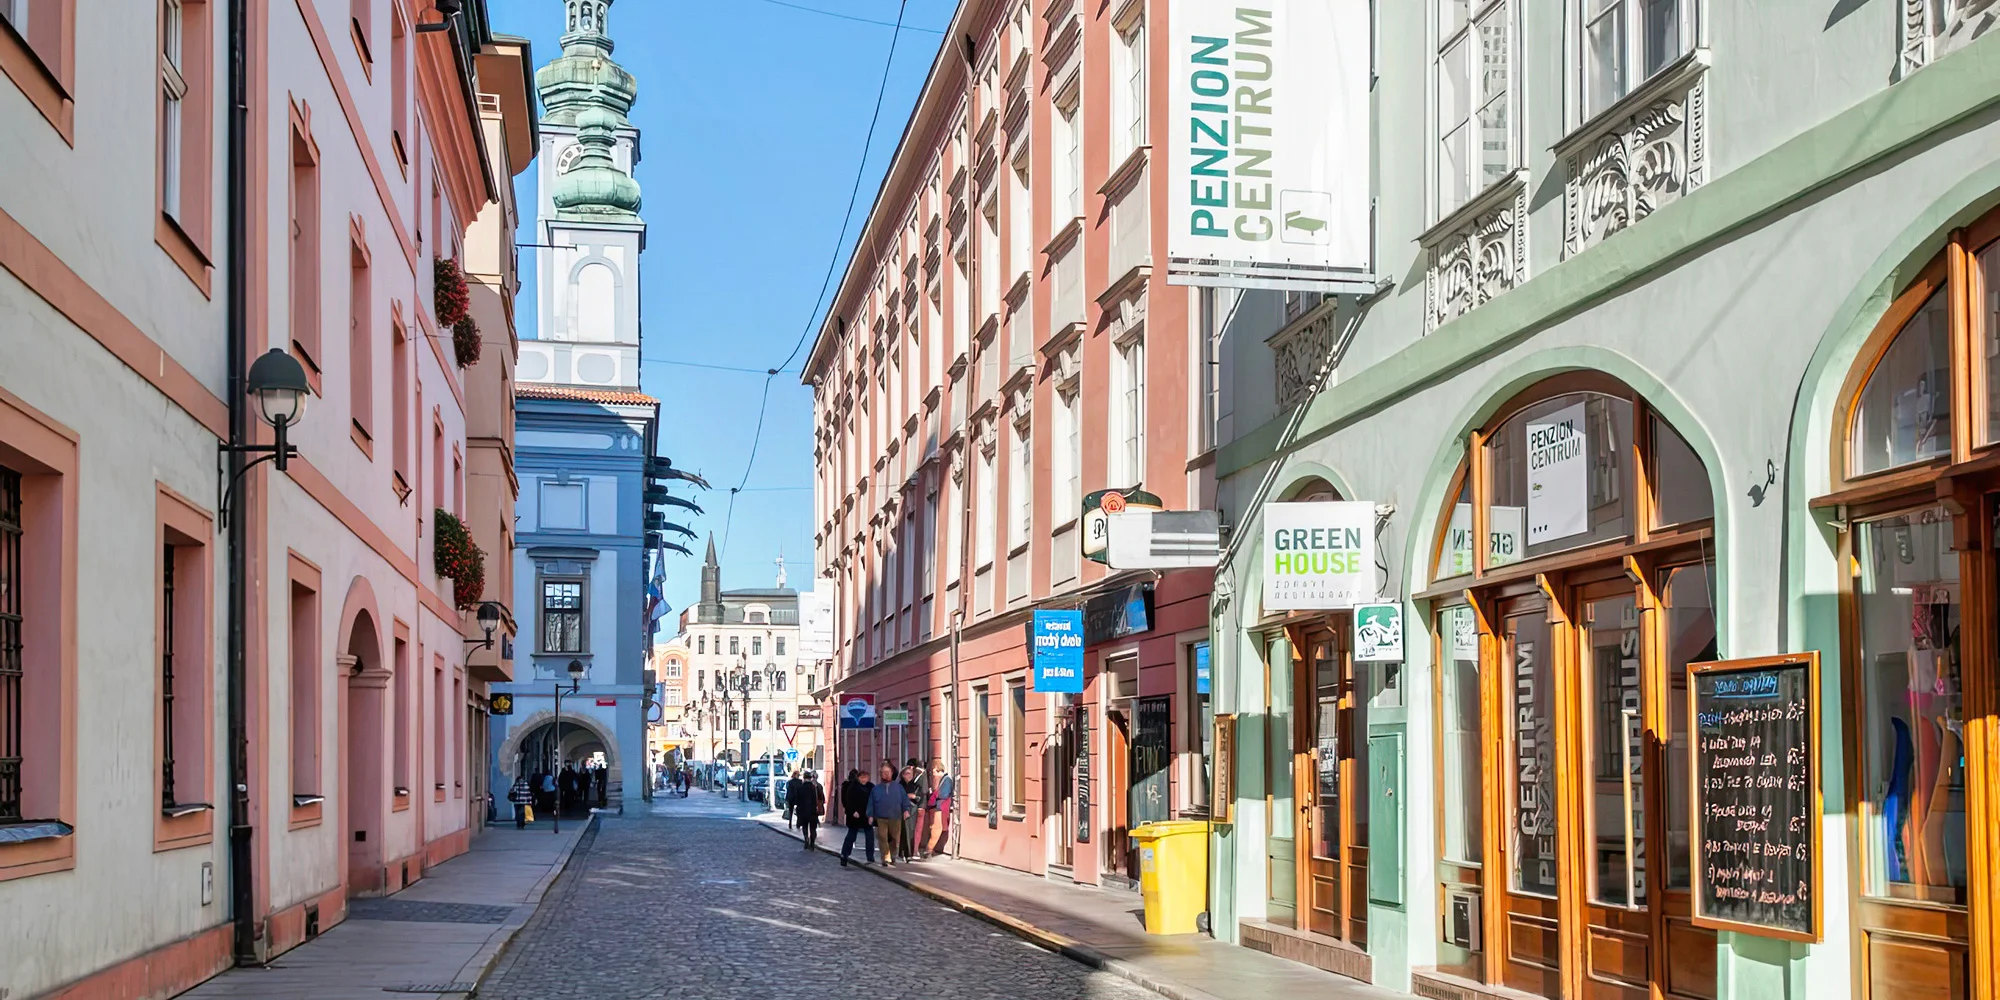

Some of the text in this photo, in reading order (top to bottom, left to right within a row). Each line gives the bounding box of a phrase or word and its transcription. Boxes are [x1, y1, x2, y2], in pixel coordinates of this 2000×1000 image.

[1191, 36, 1229, 237] PENZION
[1234, 7, 1273, 241] CENTRUM
[1531, 419, 1573, 451] PENZION
[1531, 437, 1581, 470] CENTRUM
[1275, 528, 1361, 550] GREEN
[1275, 552, 1361, 575] HOUSE
[1517, 641, 1538, 835] CENTRUM
[1537, 717, 1555, 885] PENZION
